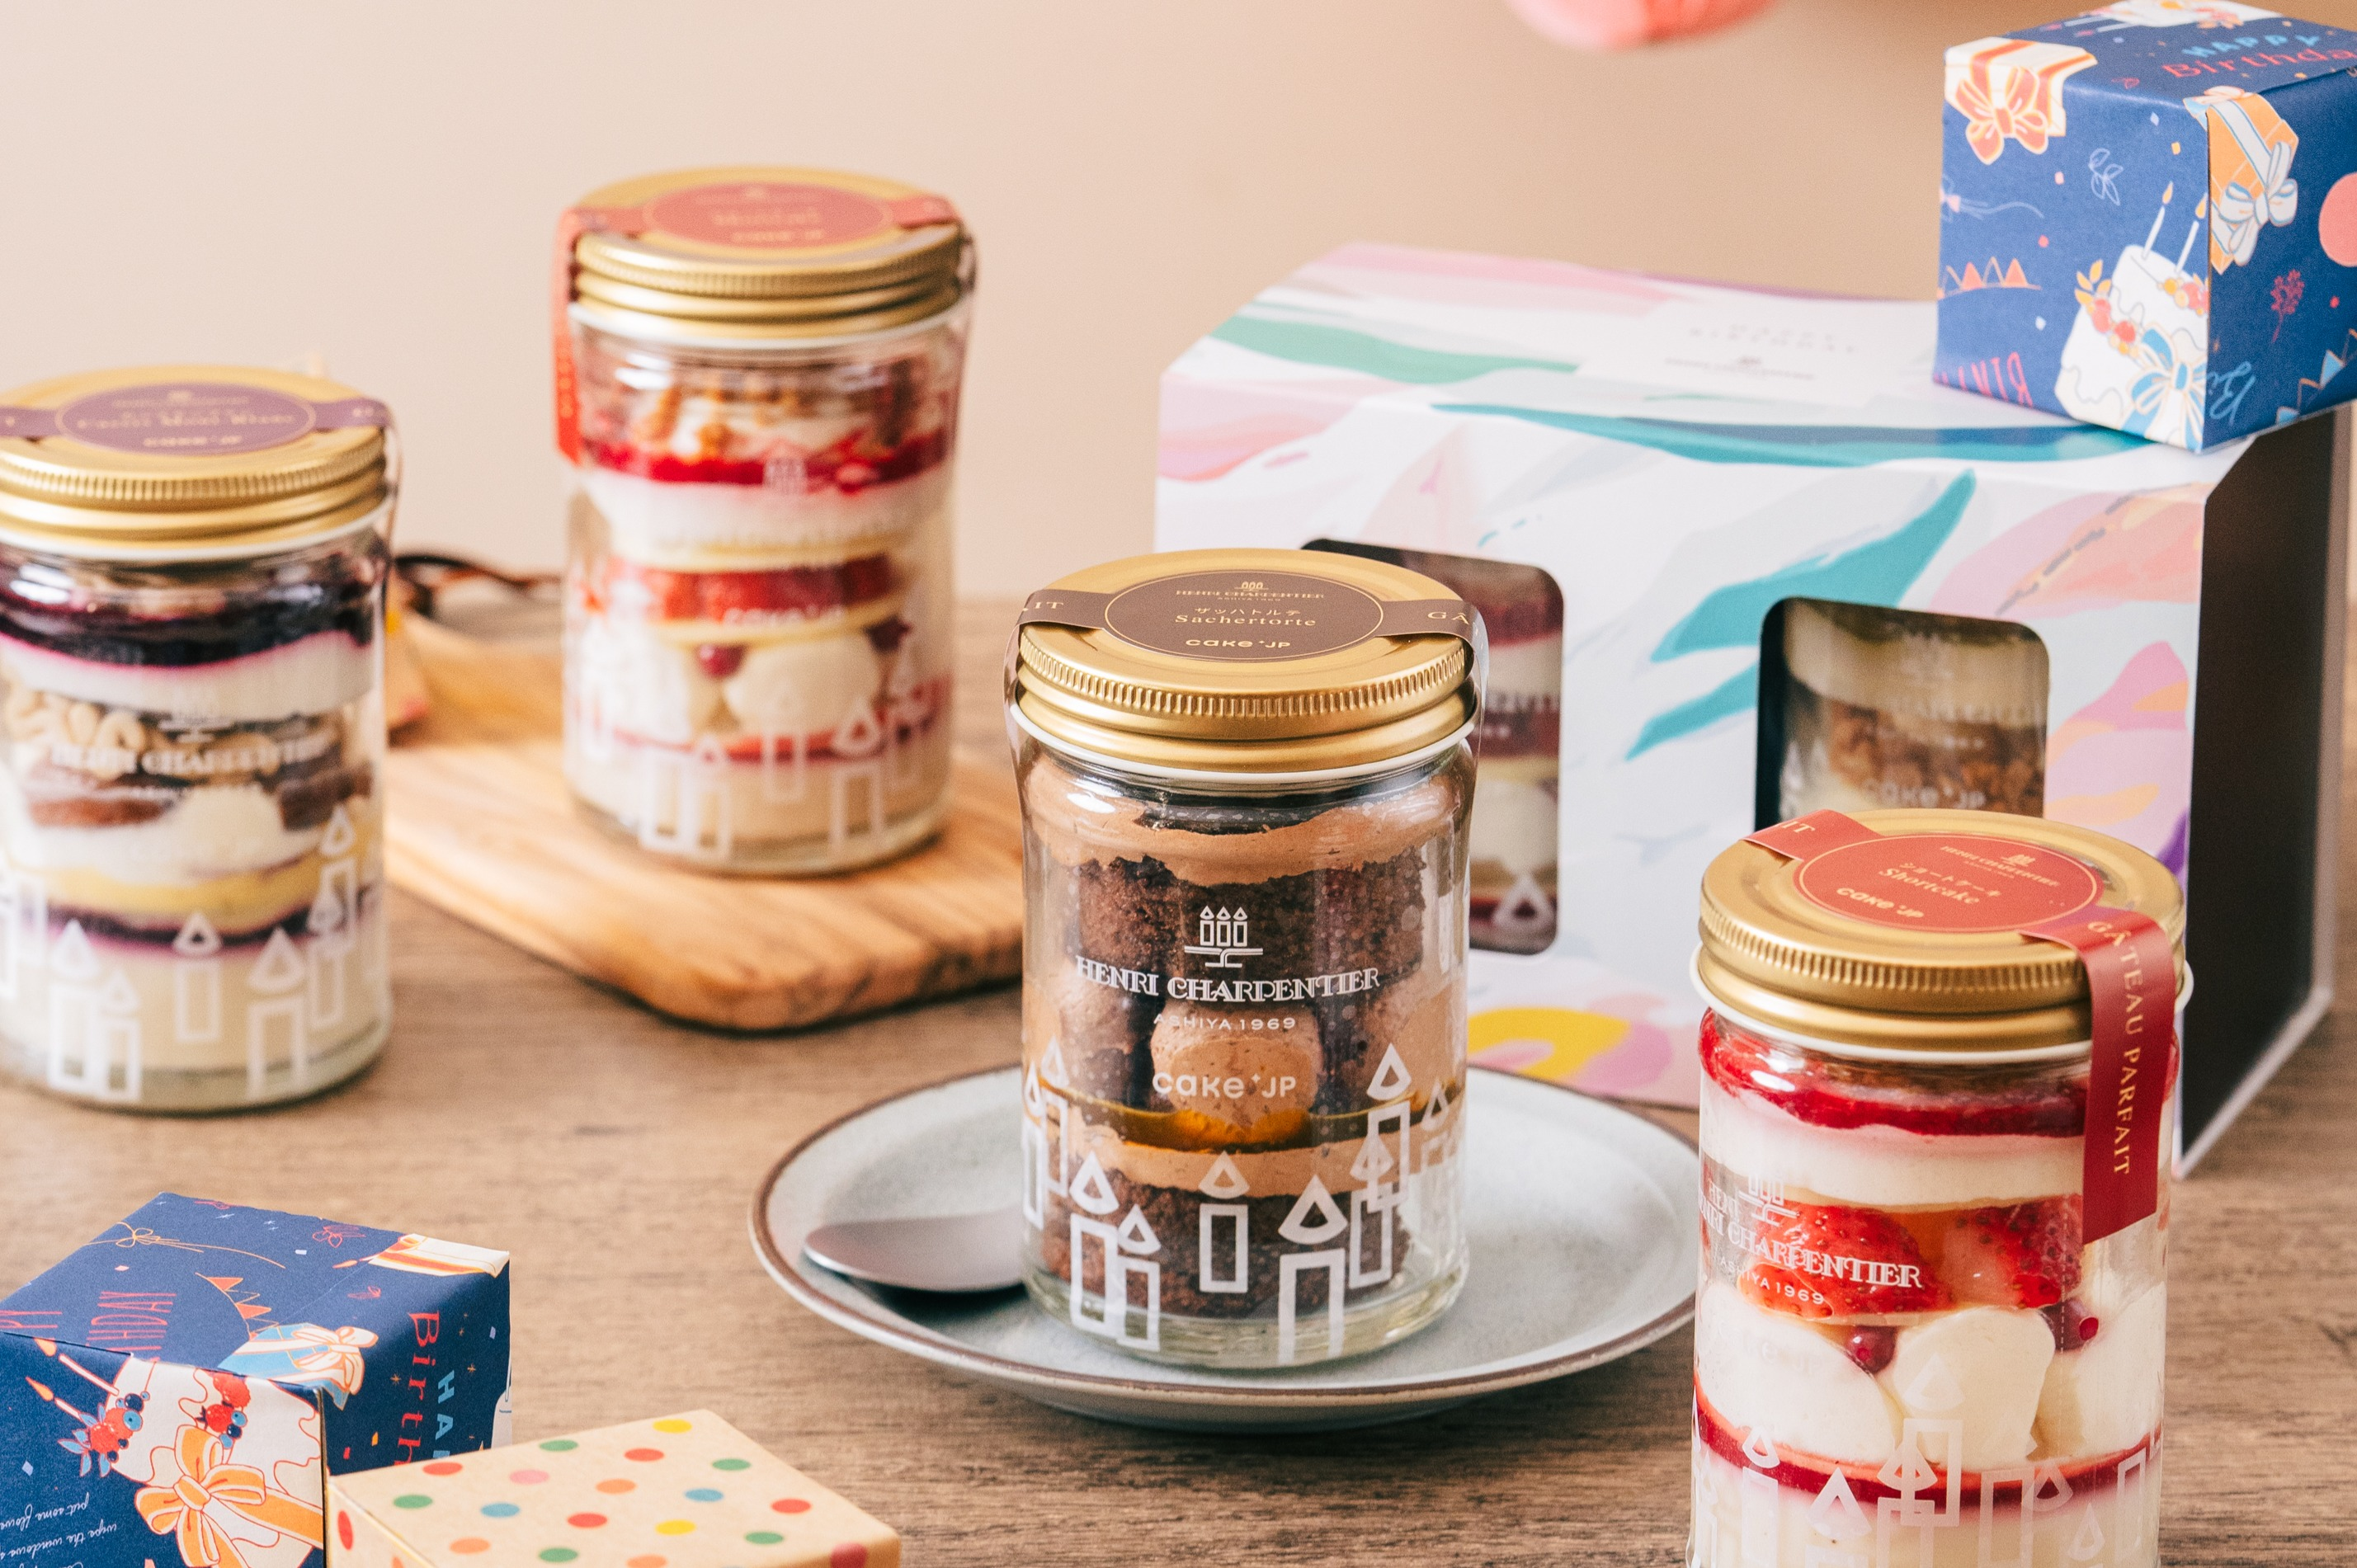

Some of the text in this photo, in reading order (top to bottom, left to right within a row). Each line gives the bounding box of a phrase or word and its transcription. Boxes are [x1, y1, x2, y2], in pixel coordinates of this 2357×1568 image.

[1175, 614, 1316, 626] Sachertorte
[1195, 607, 1301, 616] ザッハトルテ
[1186, 639, 1253, 647] cake
[1879, 868, 1980, 904] Shortcake
[1075, 955, 1380, 1002] HENRI CHARPENTIER
[1153, 1013, 1296, 1030] ASHIYA 1969
[1153, 1072, 1296, 1099] cake JP
[2114, 1047, 2141, 1175] PARFAIT
[1728, 1222, 1922, 1288] CHARPENTIER
[1719, 1255, 1825, 1305] ASHIYA 1969
[65, 1491, 90, 1516] put
[66, 1532, 86, 1547] the
